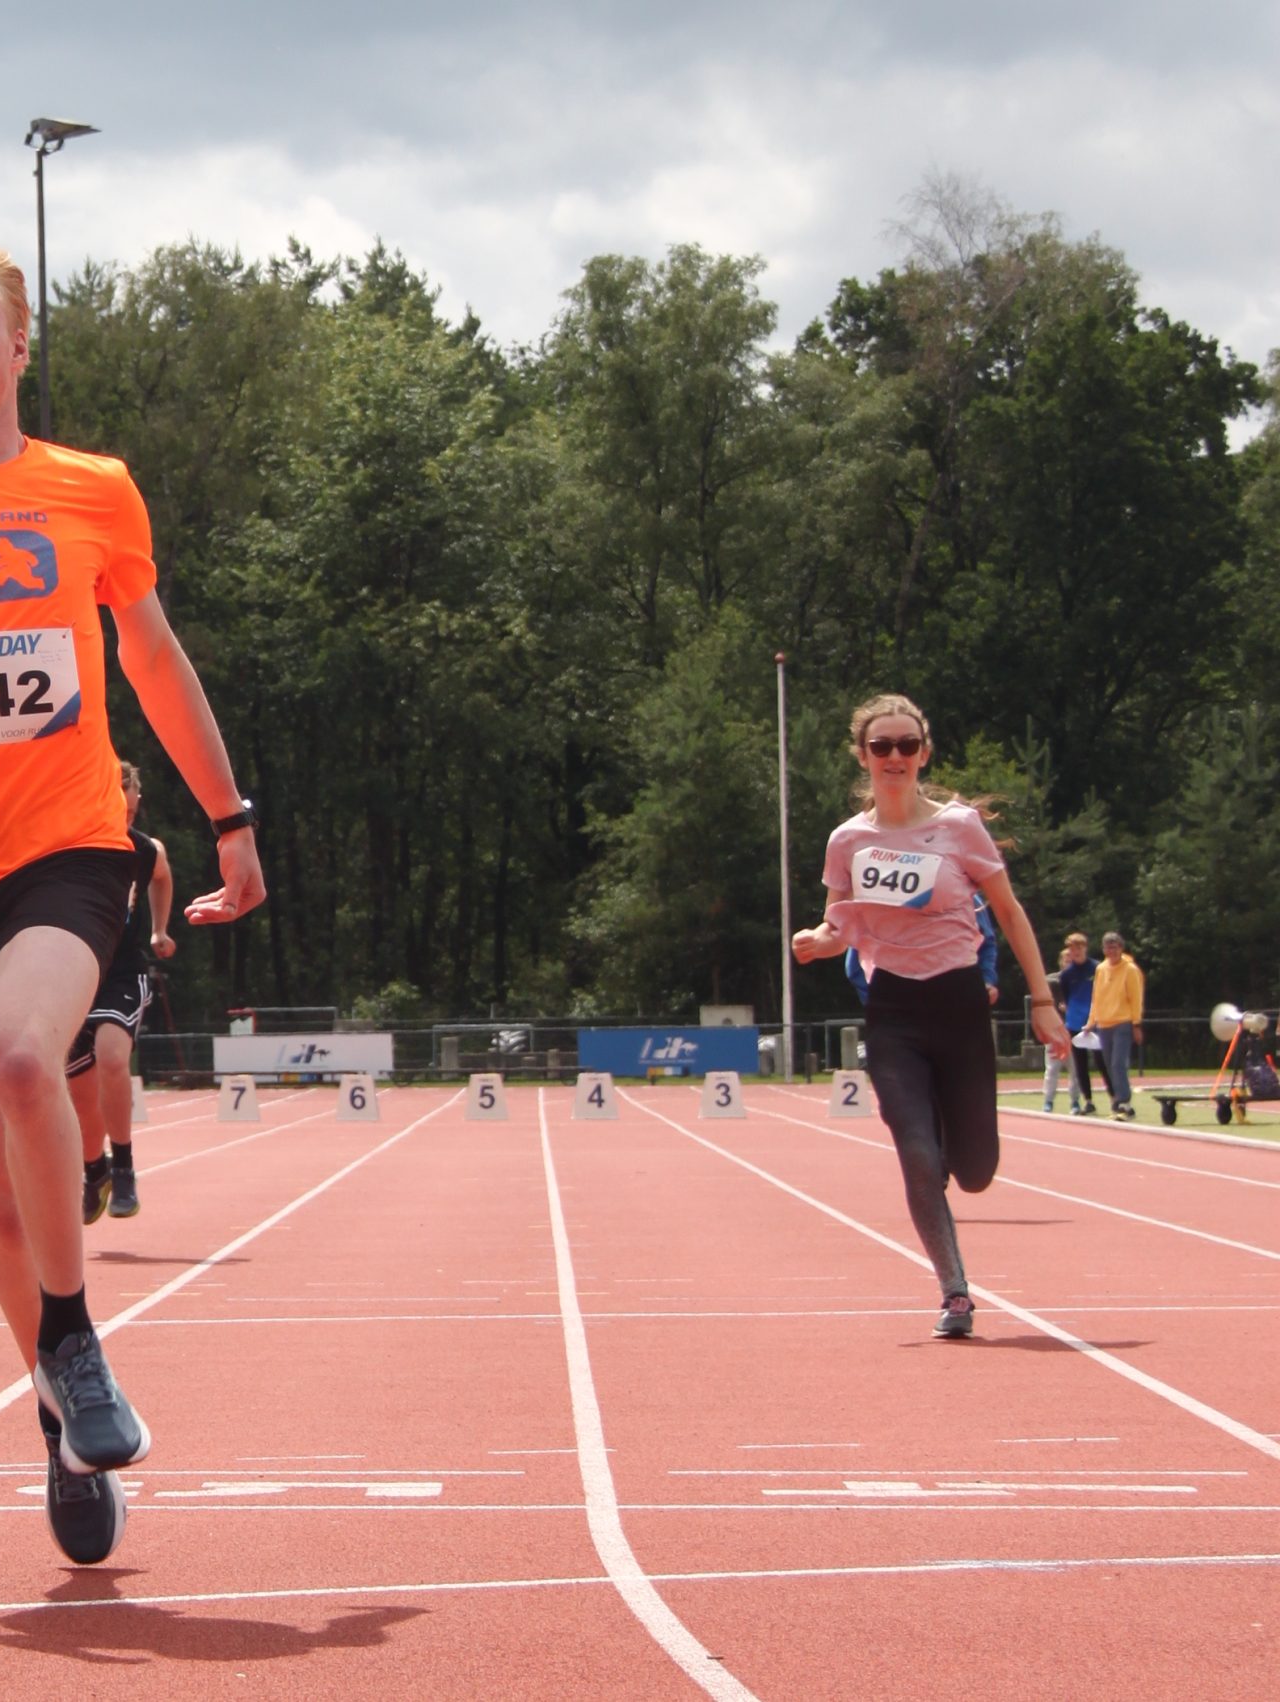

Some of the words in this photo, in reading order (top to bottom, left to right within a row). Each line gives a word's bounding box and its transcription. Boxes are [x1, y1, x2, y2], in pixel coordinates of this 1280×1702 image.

[1, 727, 26, 738] VOOR
[861, 867, 920, 894] 940
[230, 1086, 246, 1110] 7
[349, 1086, 366, 1110] 6
[479, 1085, 495, 1109] 5
[587, 1083, 605, 1108] 4
[715, 1082, 732, 1107] 3
[841, 1082, 859, 1106] 2
